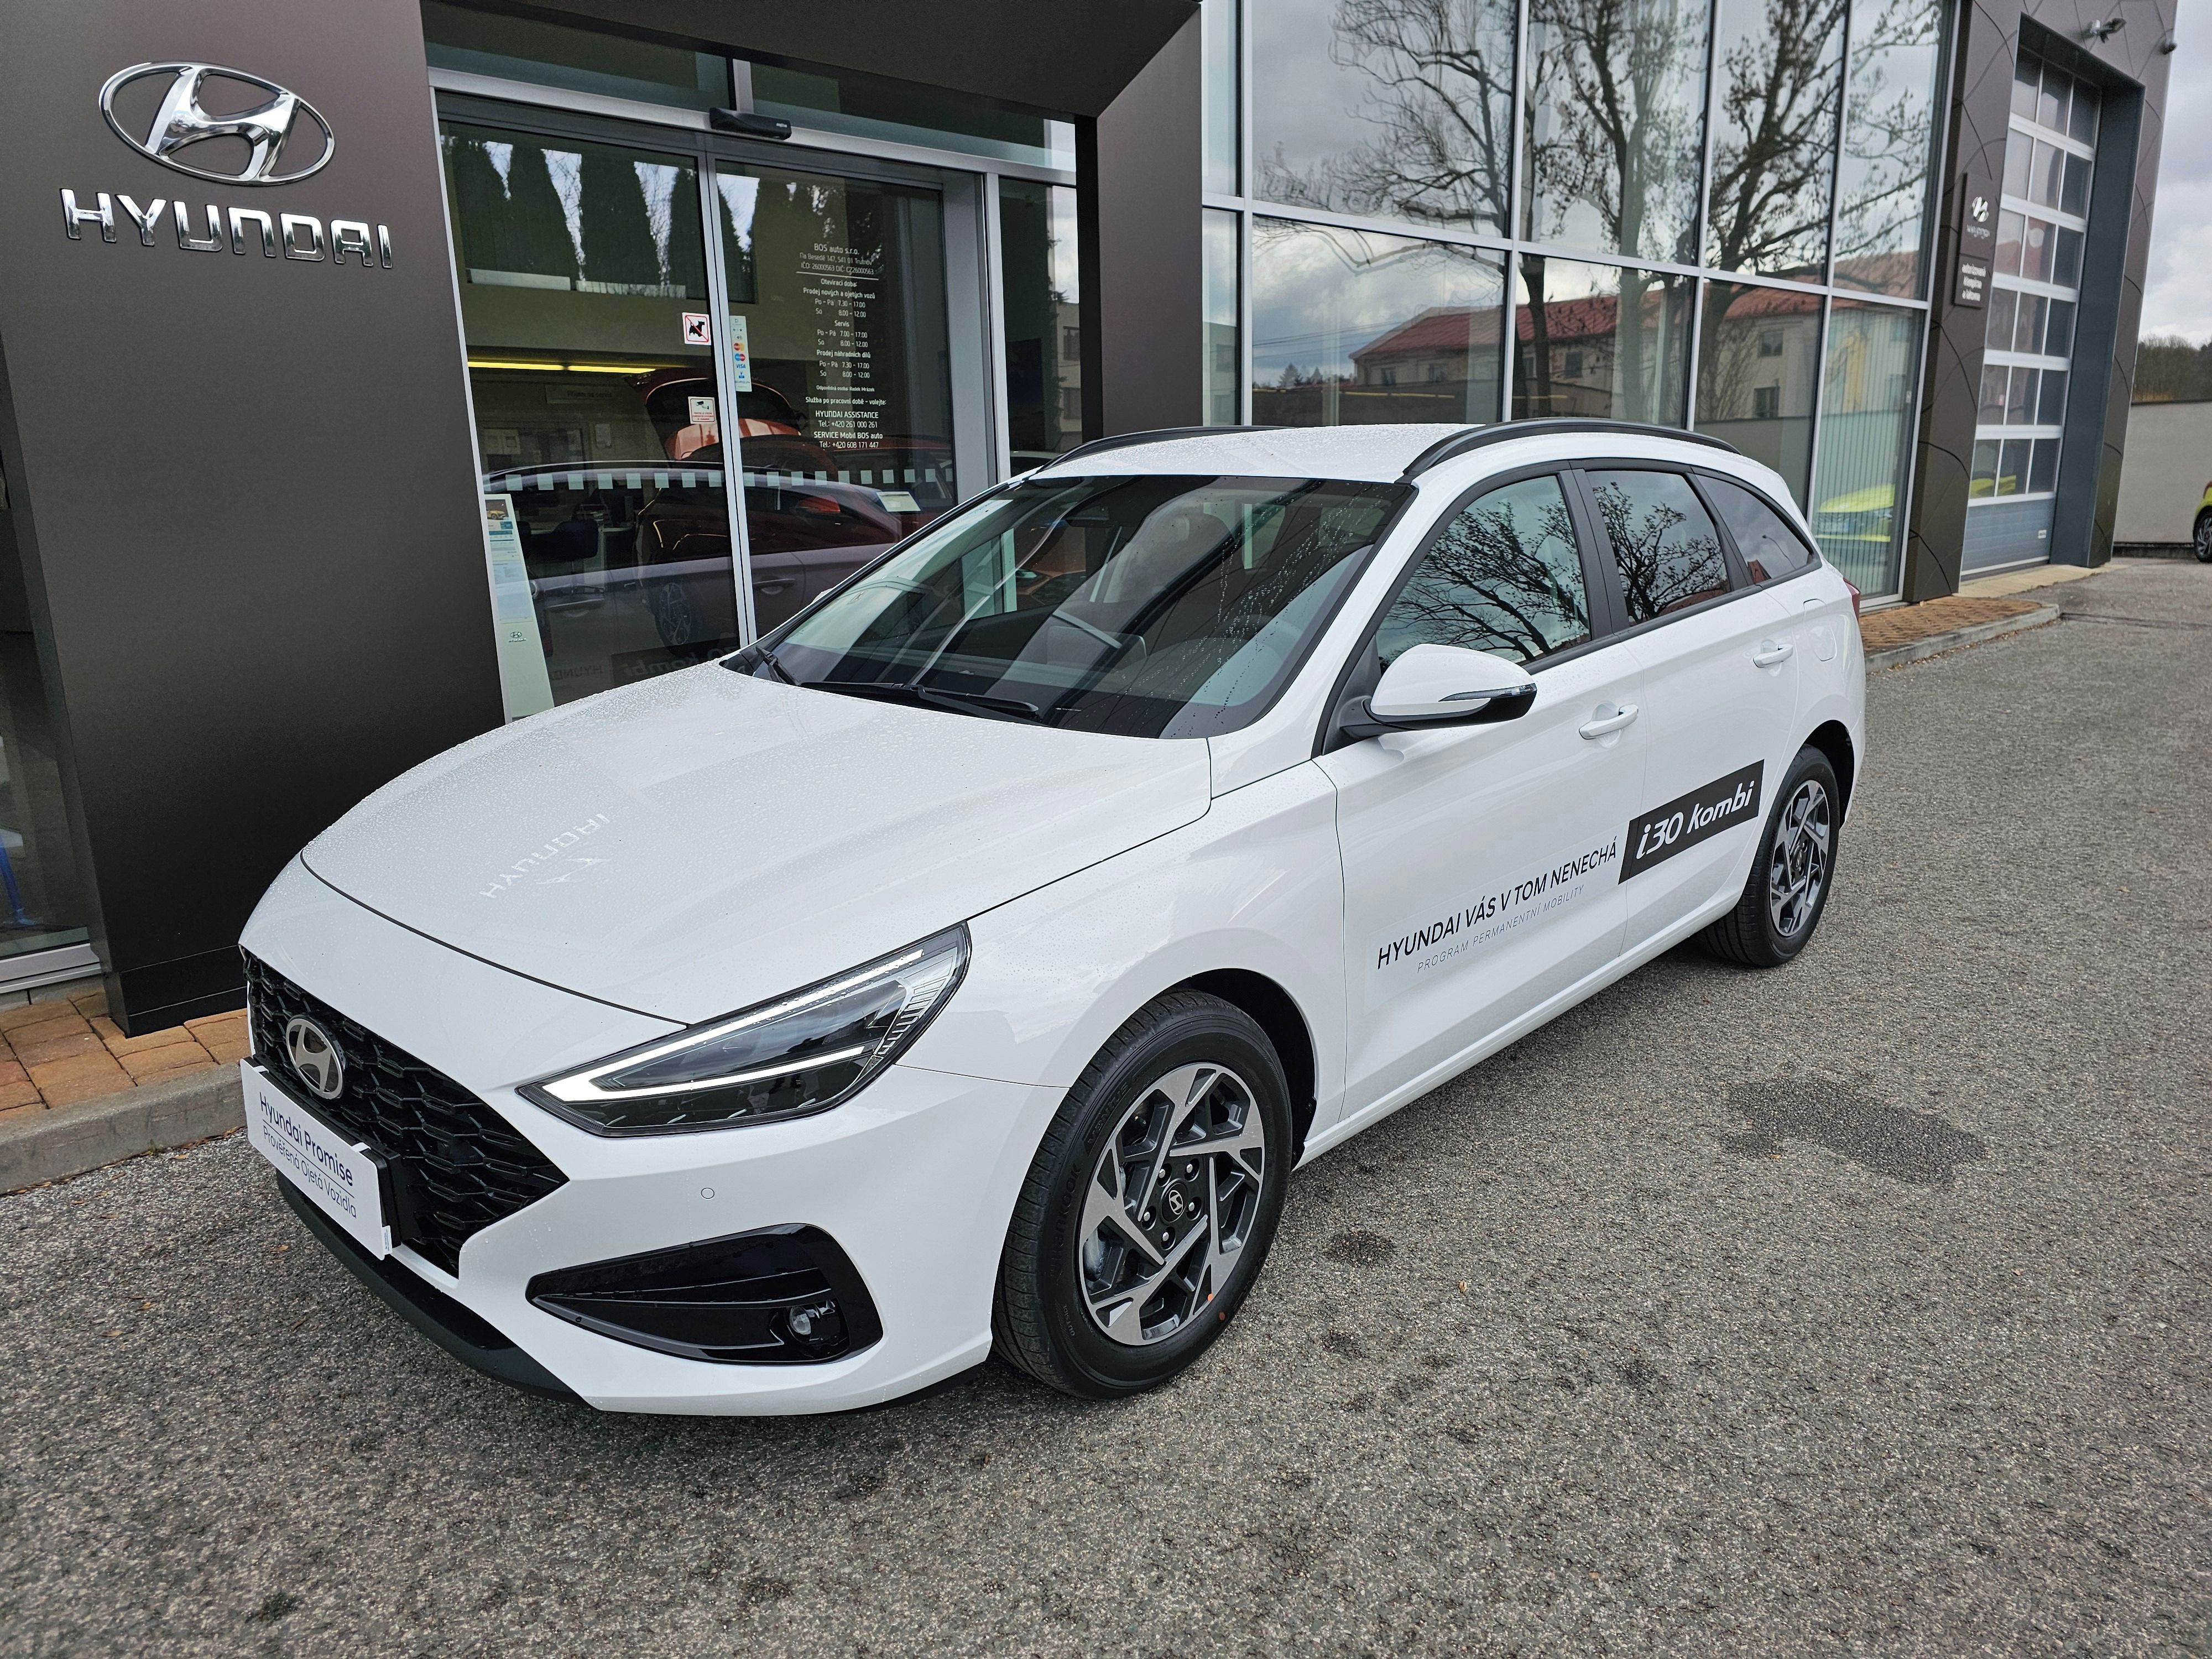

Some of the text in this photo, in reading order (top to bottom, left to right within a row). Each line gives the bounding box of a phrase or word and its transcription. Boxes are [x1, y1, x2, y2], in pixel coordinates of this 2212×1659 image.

[60, 187, 393, 269] HYUNDAI
[812, 263, 834, 271] 26000563
[814, 243, 827, 252] BOS
[803, 287, 820, 296] Prodej
[816, 349, 833, 358] Prodej
[1635, 812, 1684, 860] i30
[1687, 780, 1755, 834] kombi
[1376, 836, 1617, 969] HYUNDAI VÁS V TOM NENECHÁ
[1417, 885, 1585, 973] PROGRAM PERMANENTNÍ MOBILITY
[260, 1092, 353, 1187] Hyundai Promise
[263, 1124, 357, 1219] Prověřená Ojetá Vozidla
